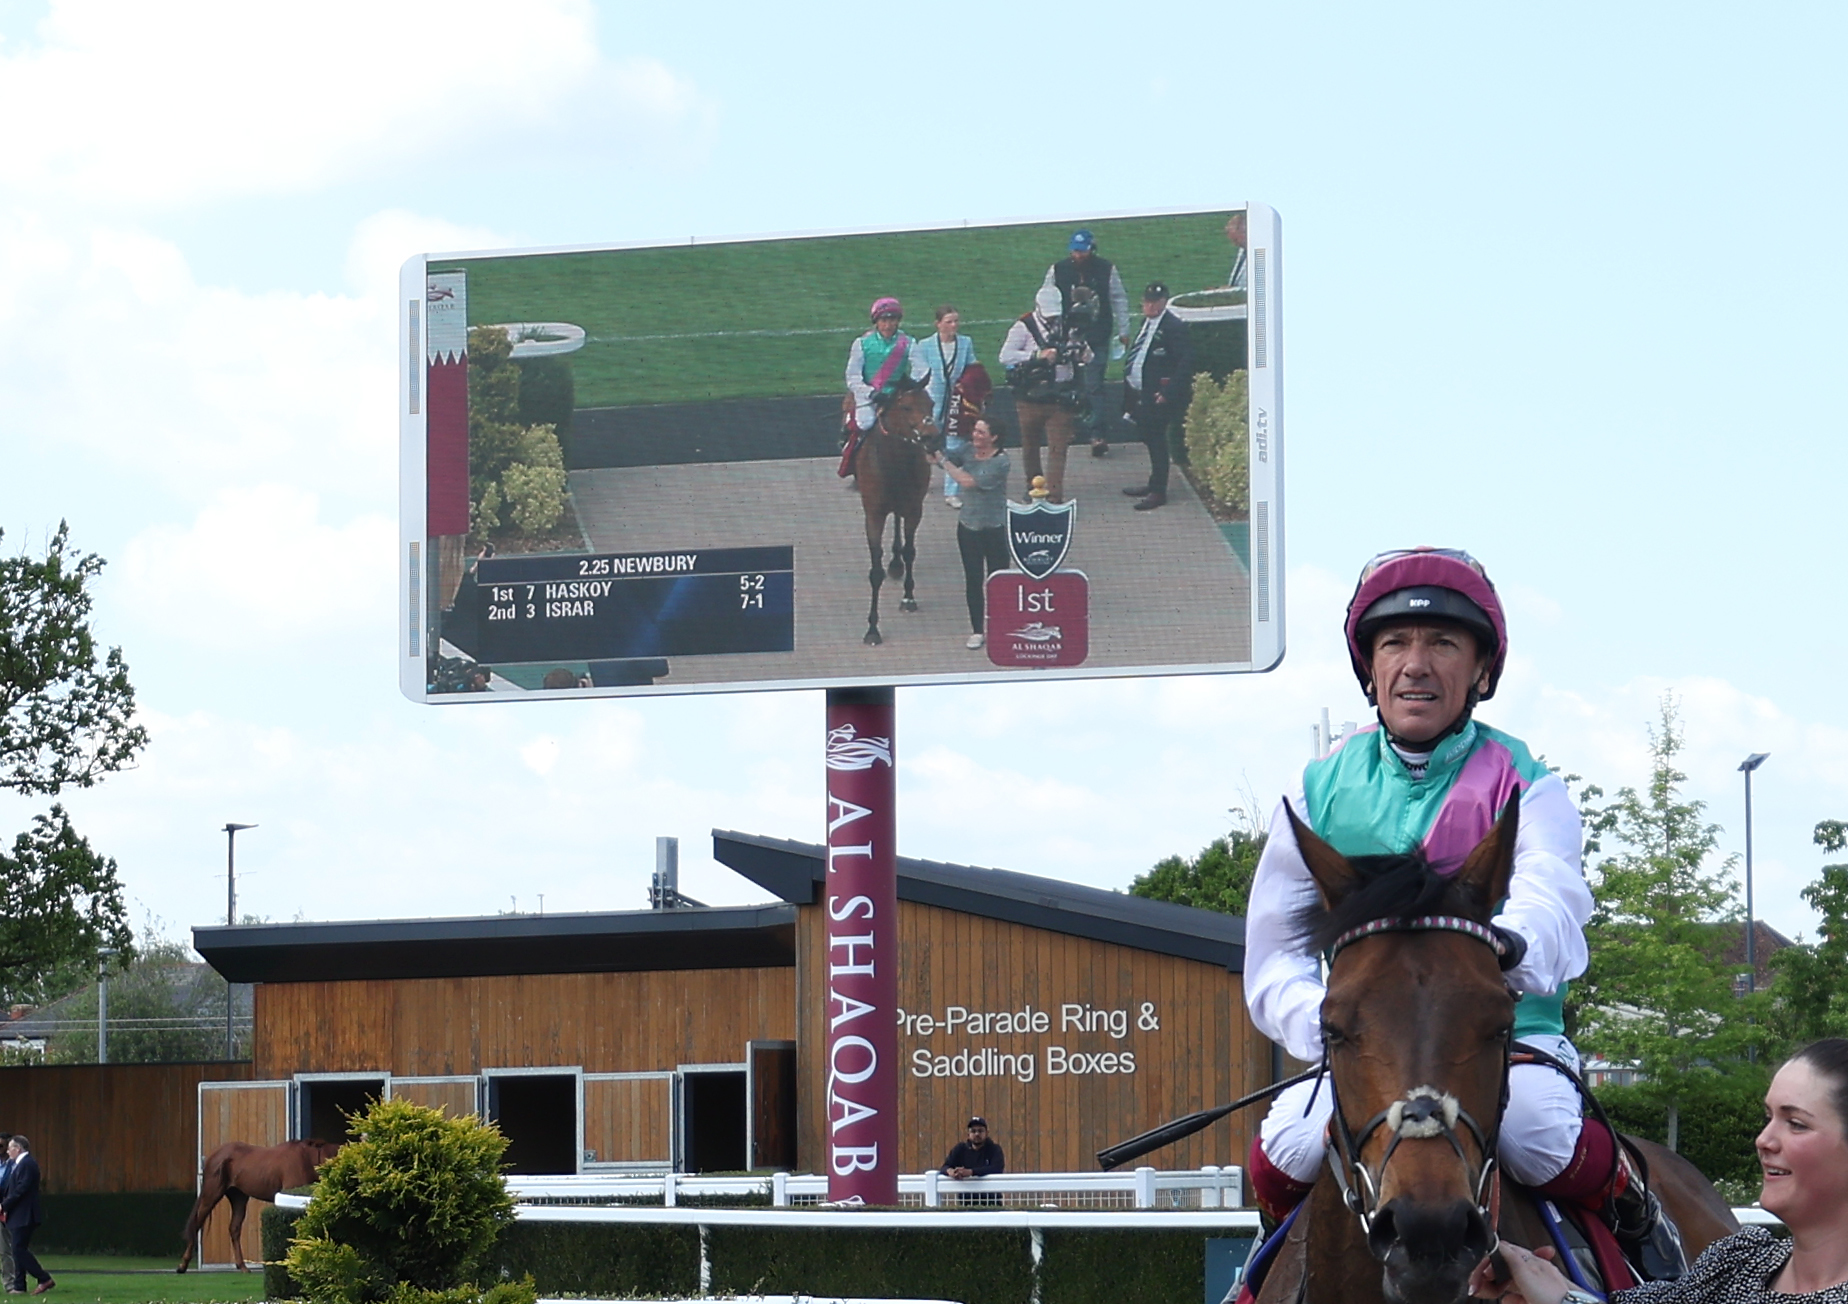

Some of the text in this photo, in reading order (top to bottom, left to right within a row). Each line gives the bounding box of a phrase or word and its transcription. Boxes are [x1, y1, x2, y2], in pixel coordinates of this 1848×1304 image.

[1256, 406, 1268, 464] adi.tv
[1014, 531, 1064, 544] Winner
[579, 555, 697, 576] 2.25 NEWBURY
[491, 575, 765, 602] 1st 7 HASKOY 5-2
[488, 593, 764, 620] 2nd 3 ISRAR 7-1
[826, 790, 879, 1176] AL SHAQAB
[1061, 1003, 1128, 1039] Ring
[1137, 1002, 1160, 1032] &
[911, 1046, 1136, 1083] Saddling Boxes
